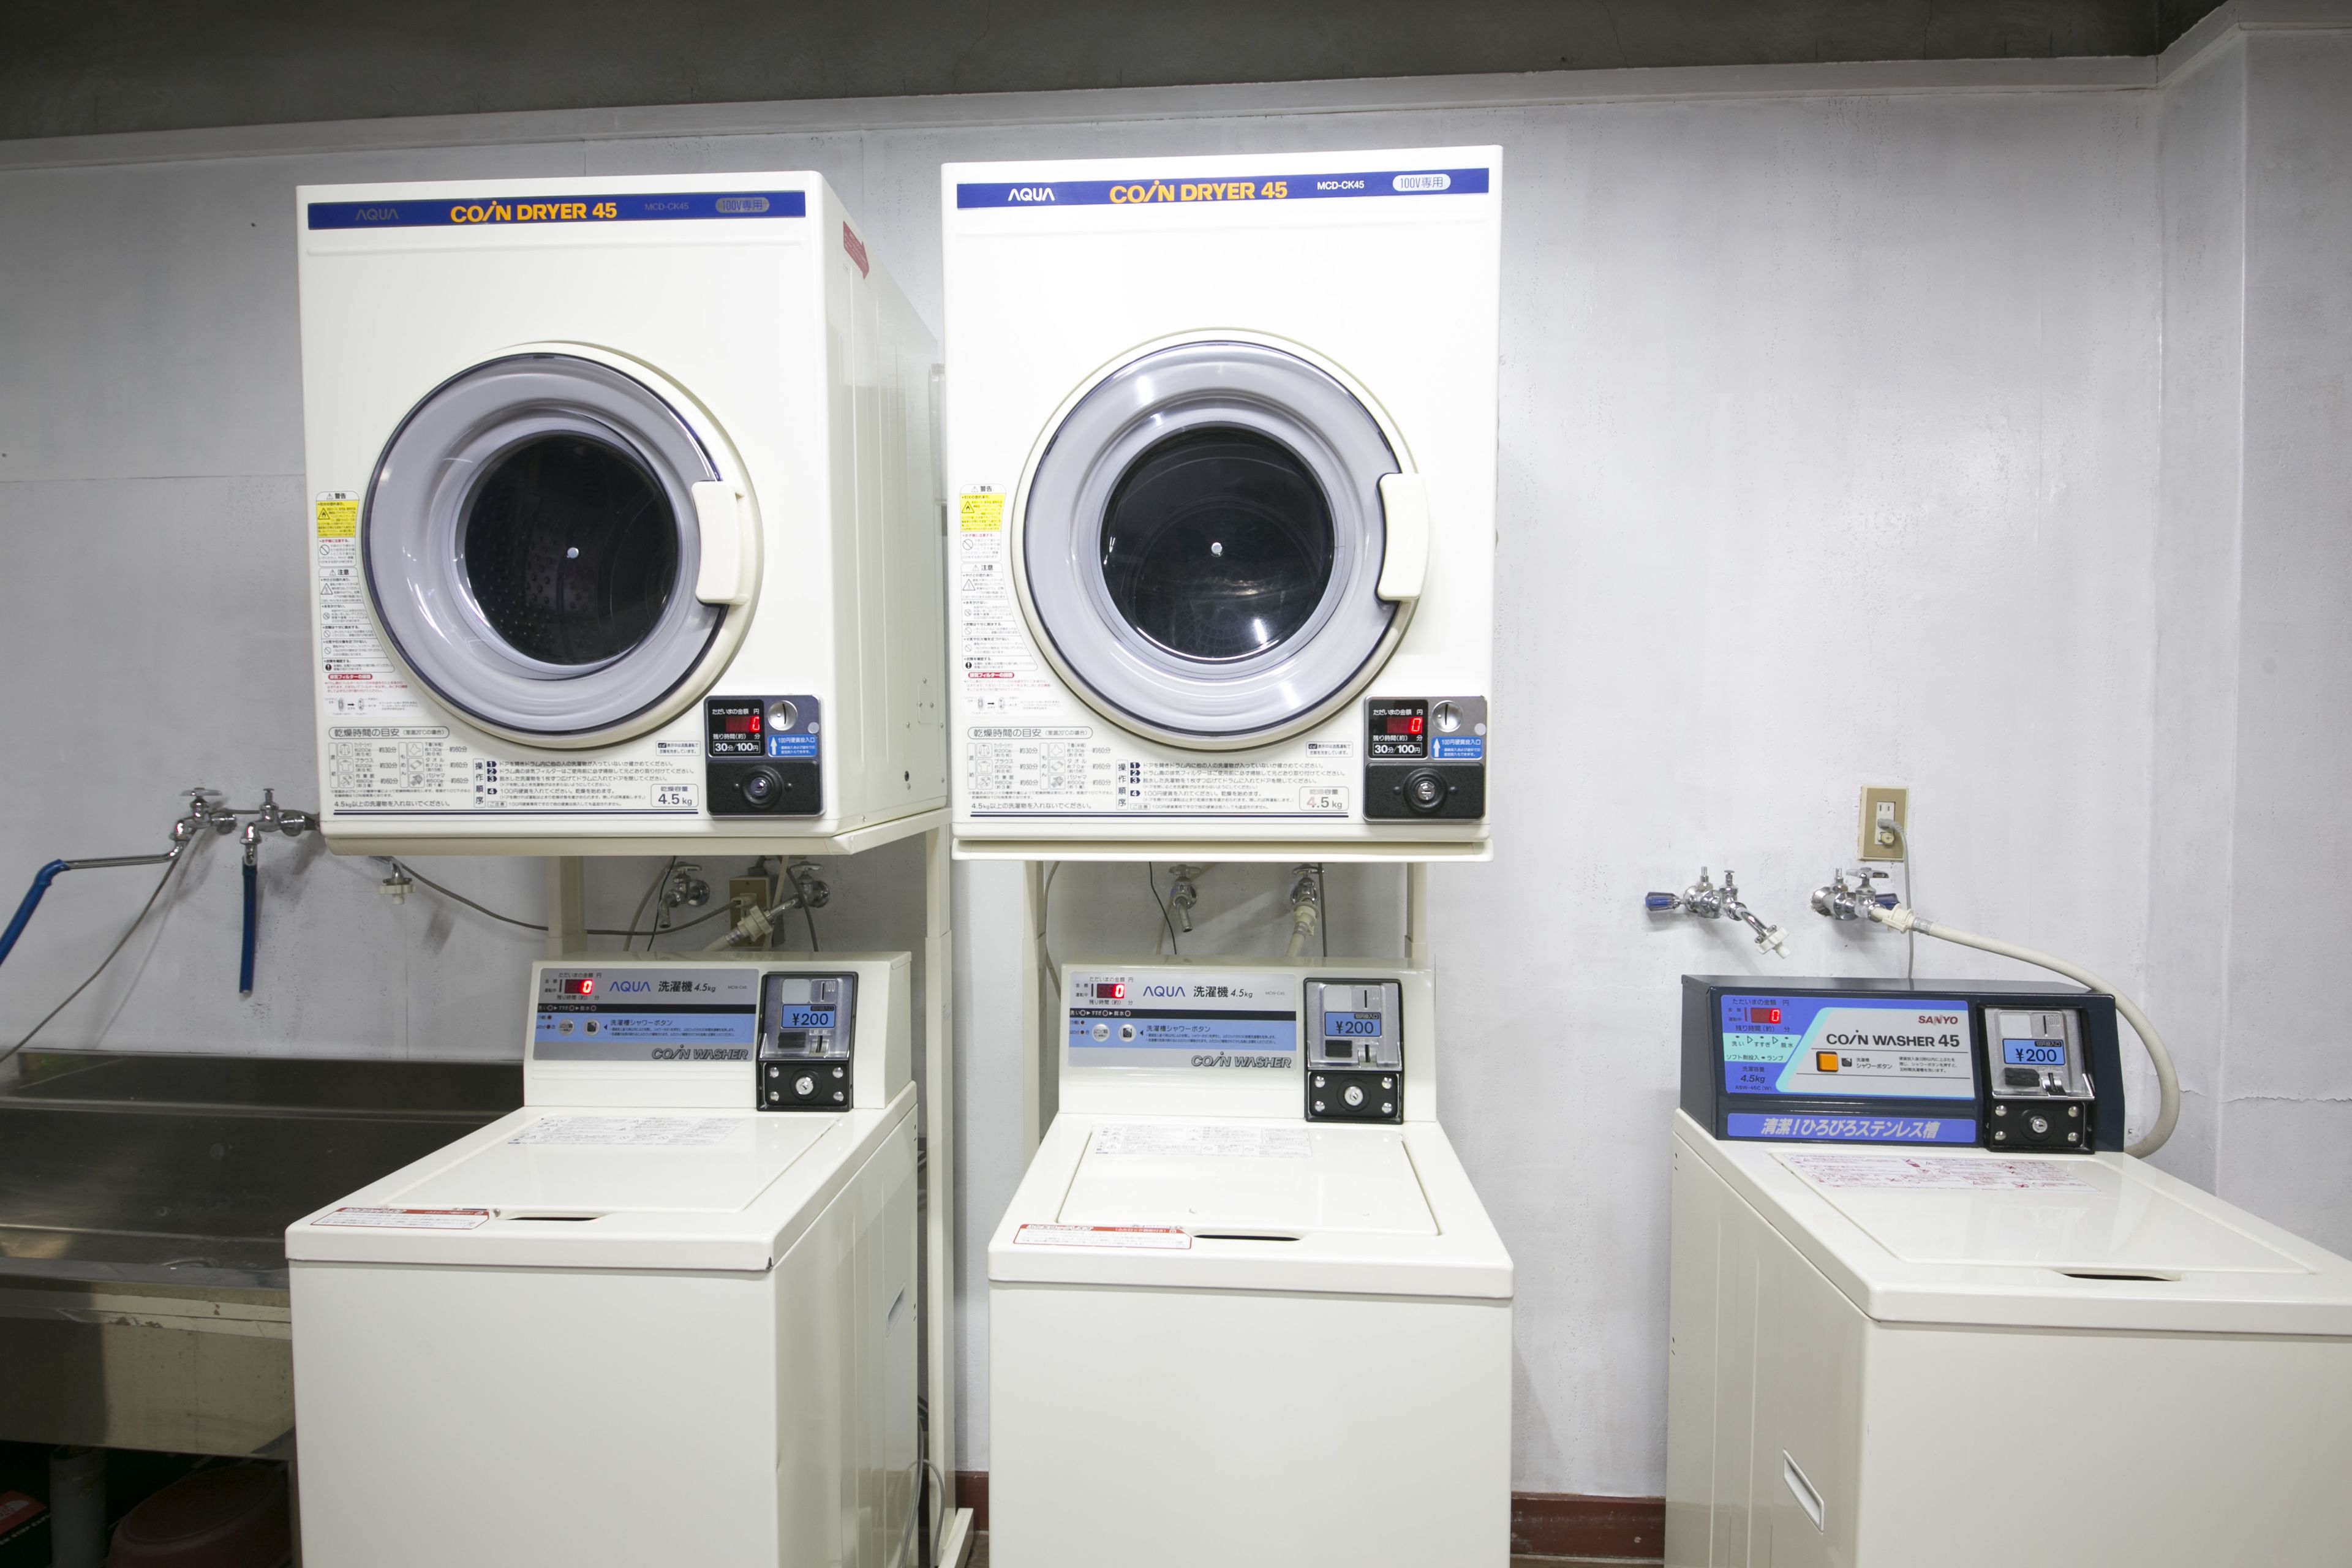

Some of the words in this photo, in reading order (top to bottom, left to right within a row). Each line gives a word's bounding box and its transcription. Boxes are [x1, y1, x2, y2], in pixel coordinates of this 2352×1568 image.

[1317, 180, 1365, 190] MCD-CK45
[1400, 176, 1444, 190] 100V専用
[1009, 188, 1055, 202] AQUA
[1181, 183, 1255, 201] DRYER
[1261, 181, 1287, 198] 45
[517, 204, 586, 221] DRYER
[592, 202, 617, 219] 45
[645, 202, 689, 211] MCD-CK45
[722, 198, 763, 213] 100V専用
[355, 209, 399, 221] AQUA
[753, 717, 760, 730] 0
[1411, 718, 1422, 731] 0
[334, 729, 399, 737] 乾燥時間の目安
[974, 729, 1041, 737] 乾燥時間の目安
[475, 762, 484, 805] 操作順序
[658, 793, 680, 805] 4.5
[1306, 797, 1329, 808] 4.5
[582, 980, 593, 993] 0
[609, 981, 650, 992] AQUA
[658, 981, 693, 992] 洗濯機
[694, 983, 716, 993] 4.5kg
[1115, 984, 1124, 998] 0
[1143, 986, 1186, 997] AQUA
[1193, 986, 1229, 998] 洗濯機
[1231, 989, 1253, 999] 4.5kg
[792, 1013, 829, 1026] ¥200
[1771, 1009, 1780, 1022] 0
[1918, 1015, 1958, 1025] SANYO
[1336, 1021, 1374, 1034] ¥200
[1872, 1035, 1936, 1047] WASHER
[1938, 1034, 1960, 1047] 45
[693, 1049, 748, 1060] WASHER
[2015, 1048, 2057, 1063] ¥200
[1234, 1057, 1291, 1068] WASHER
[1740, 1074, 1766, 1084] 4.5kg
